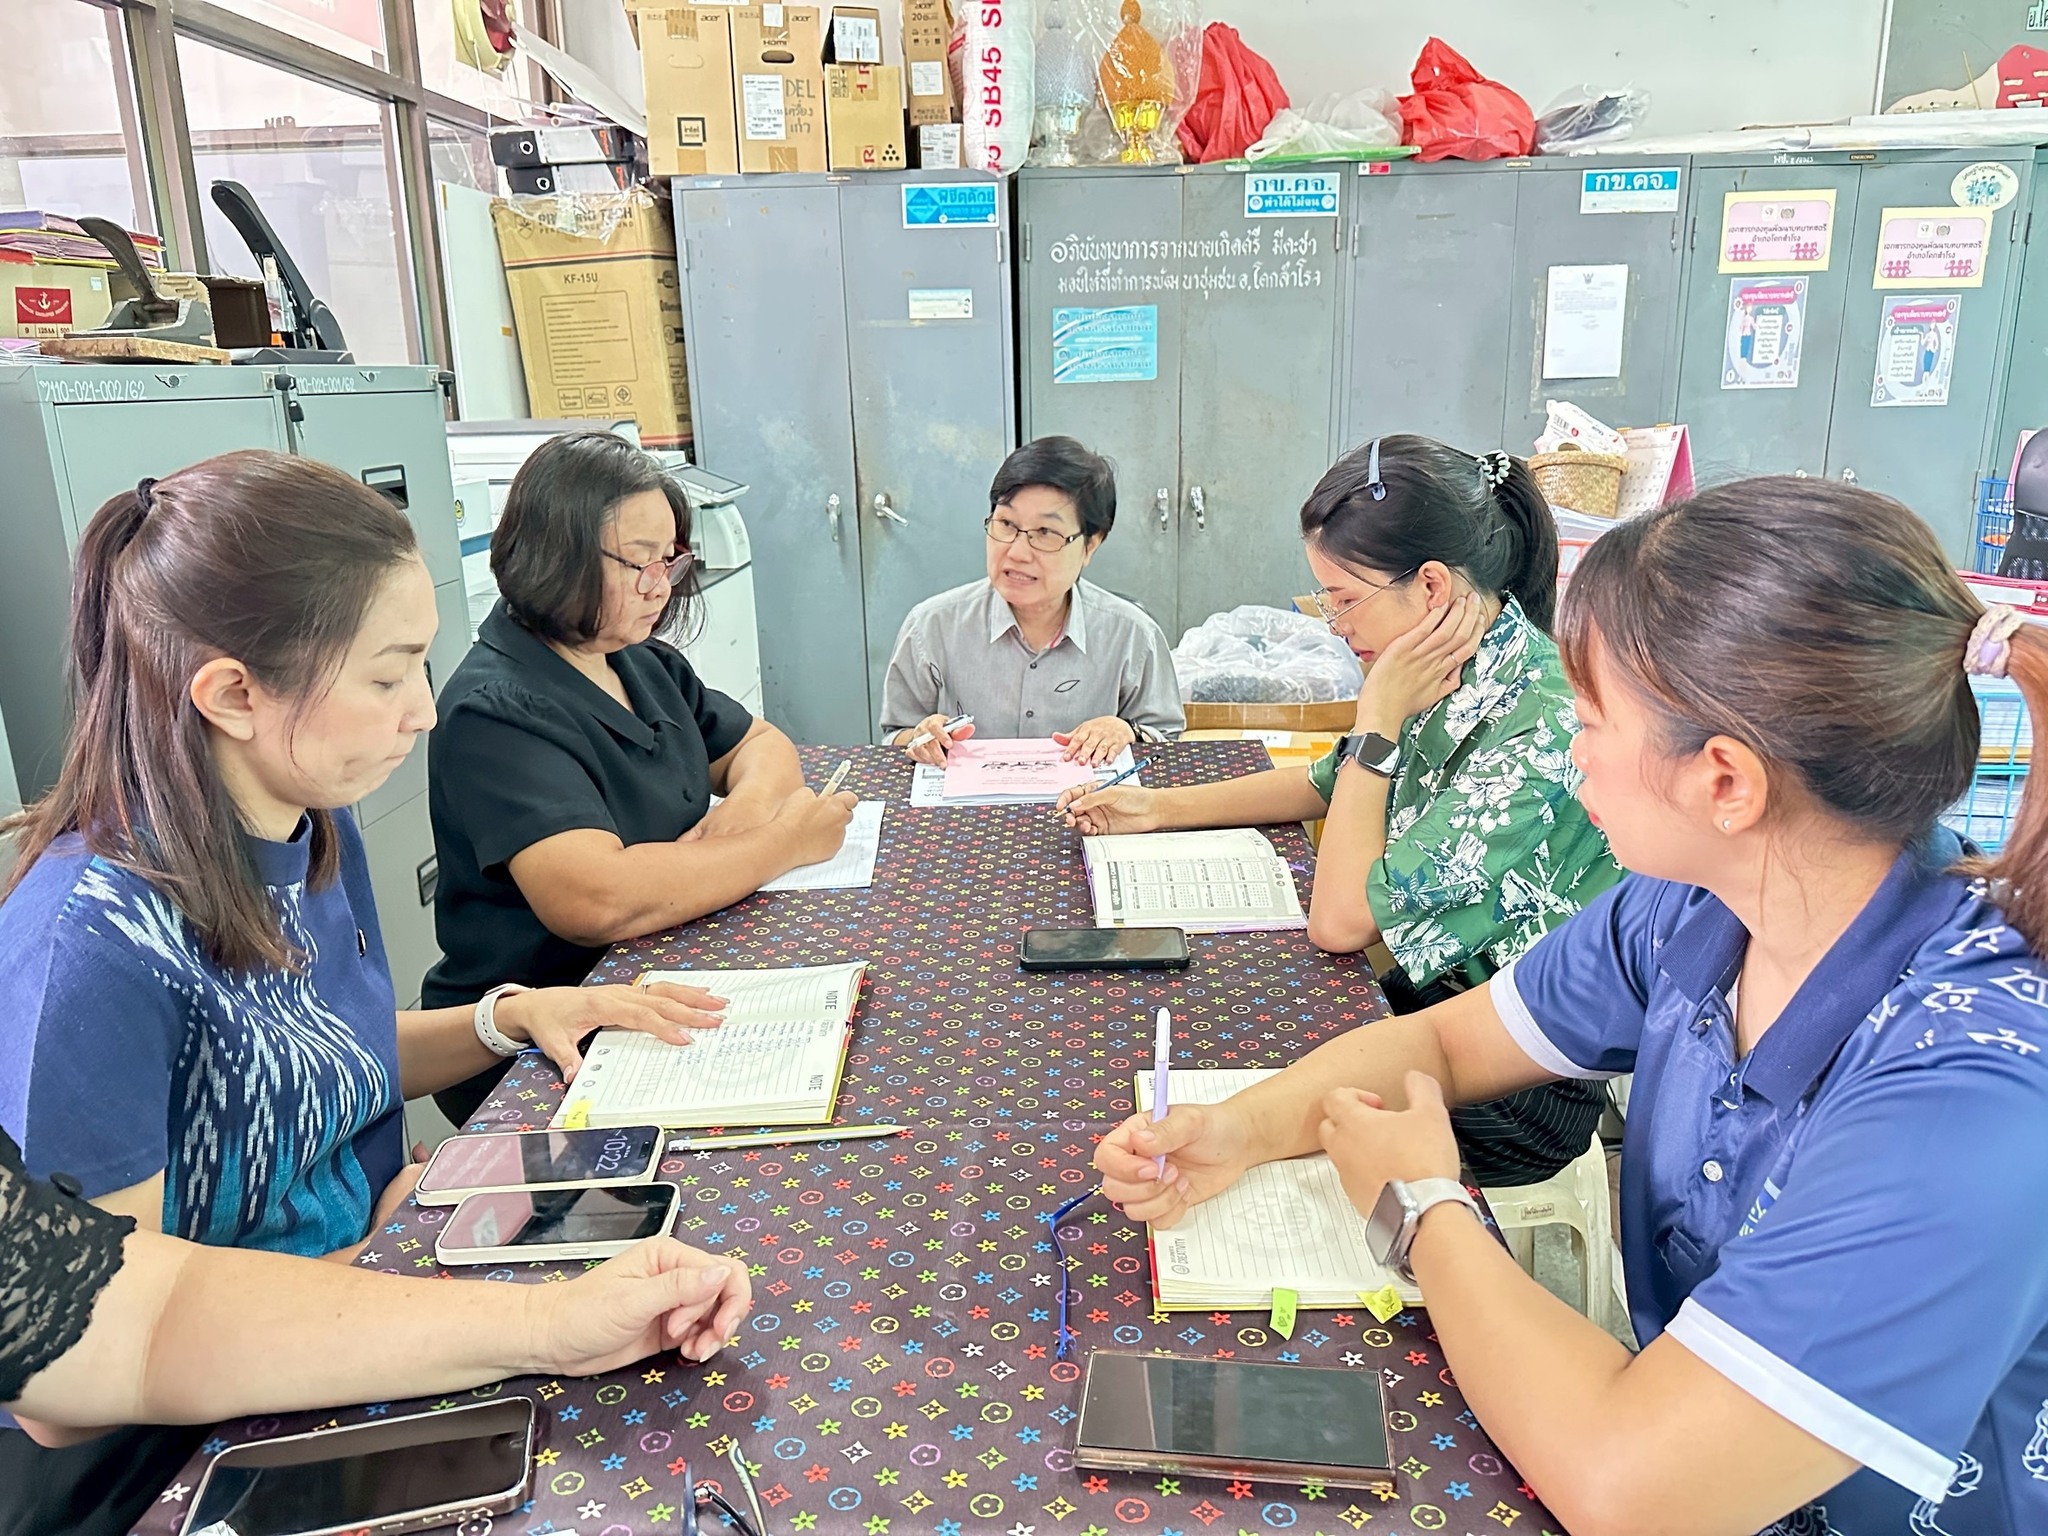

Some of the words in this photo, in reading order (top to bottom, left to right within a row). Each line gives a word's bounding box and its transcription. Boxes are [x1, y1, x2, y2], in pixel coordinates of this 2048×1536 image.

[700, 14, 720, 22] acer
[792, 14, 811, 22] acer
[982, 47, 1002, 128] SB45
[1254, 178, 1332, 192] กข.คจ.
[1595, 173, 1670, 191] กข.คจ.
[563, 273, 599, 284] KF-15U
[825, 990, 839, 1010] NOTE
[808, 1074, 823, 1091] NOTE
[595, 1135, 628, 1171] 10:22
[1175, 1238, 1188, 1264] CREATIVITY
